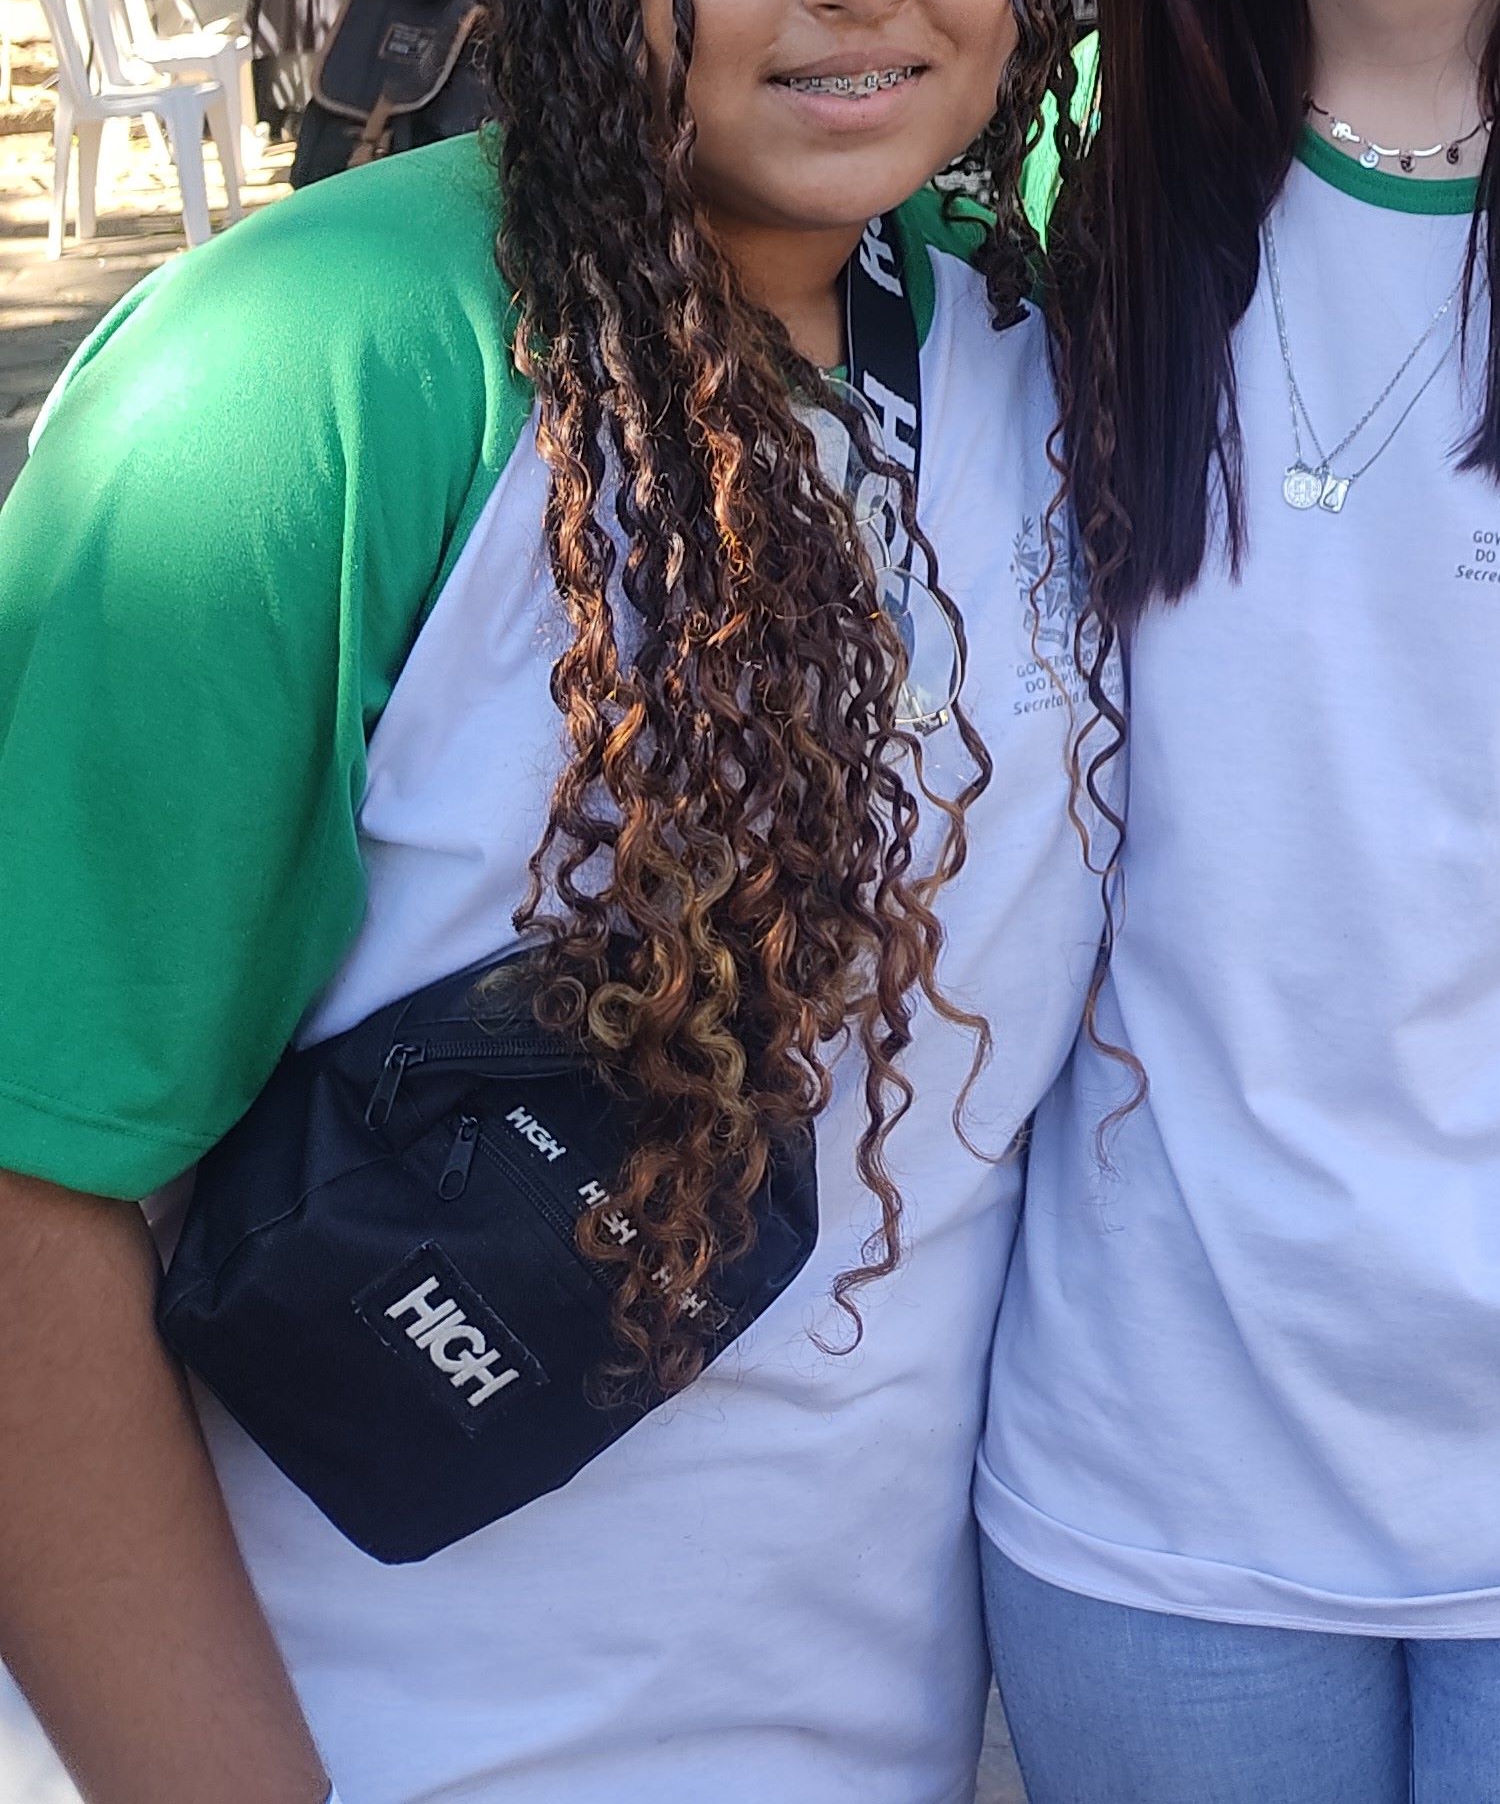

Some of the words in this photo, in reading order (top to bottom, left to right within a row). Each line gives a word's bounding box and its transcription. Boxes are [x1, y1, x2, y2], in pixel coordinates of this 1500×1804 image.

[1475, 549, 1495, 563] DO
[1025, 677, 1046, 693] DO
[505, 1106, 567, 1163] HIGH
[651, 1265, 708, 1318] HH
[384, 1276, 520, 1408] HIGH
